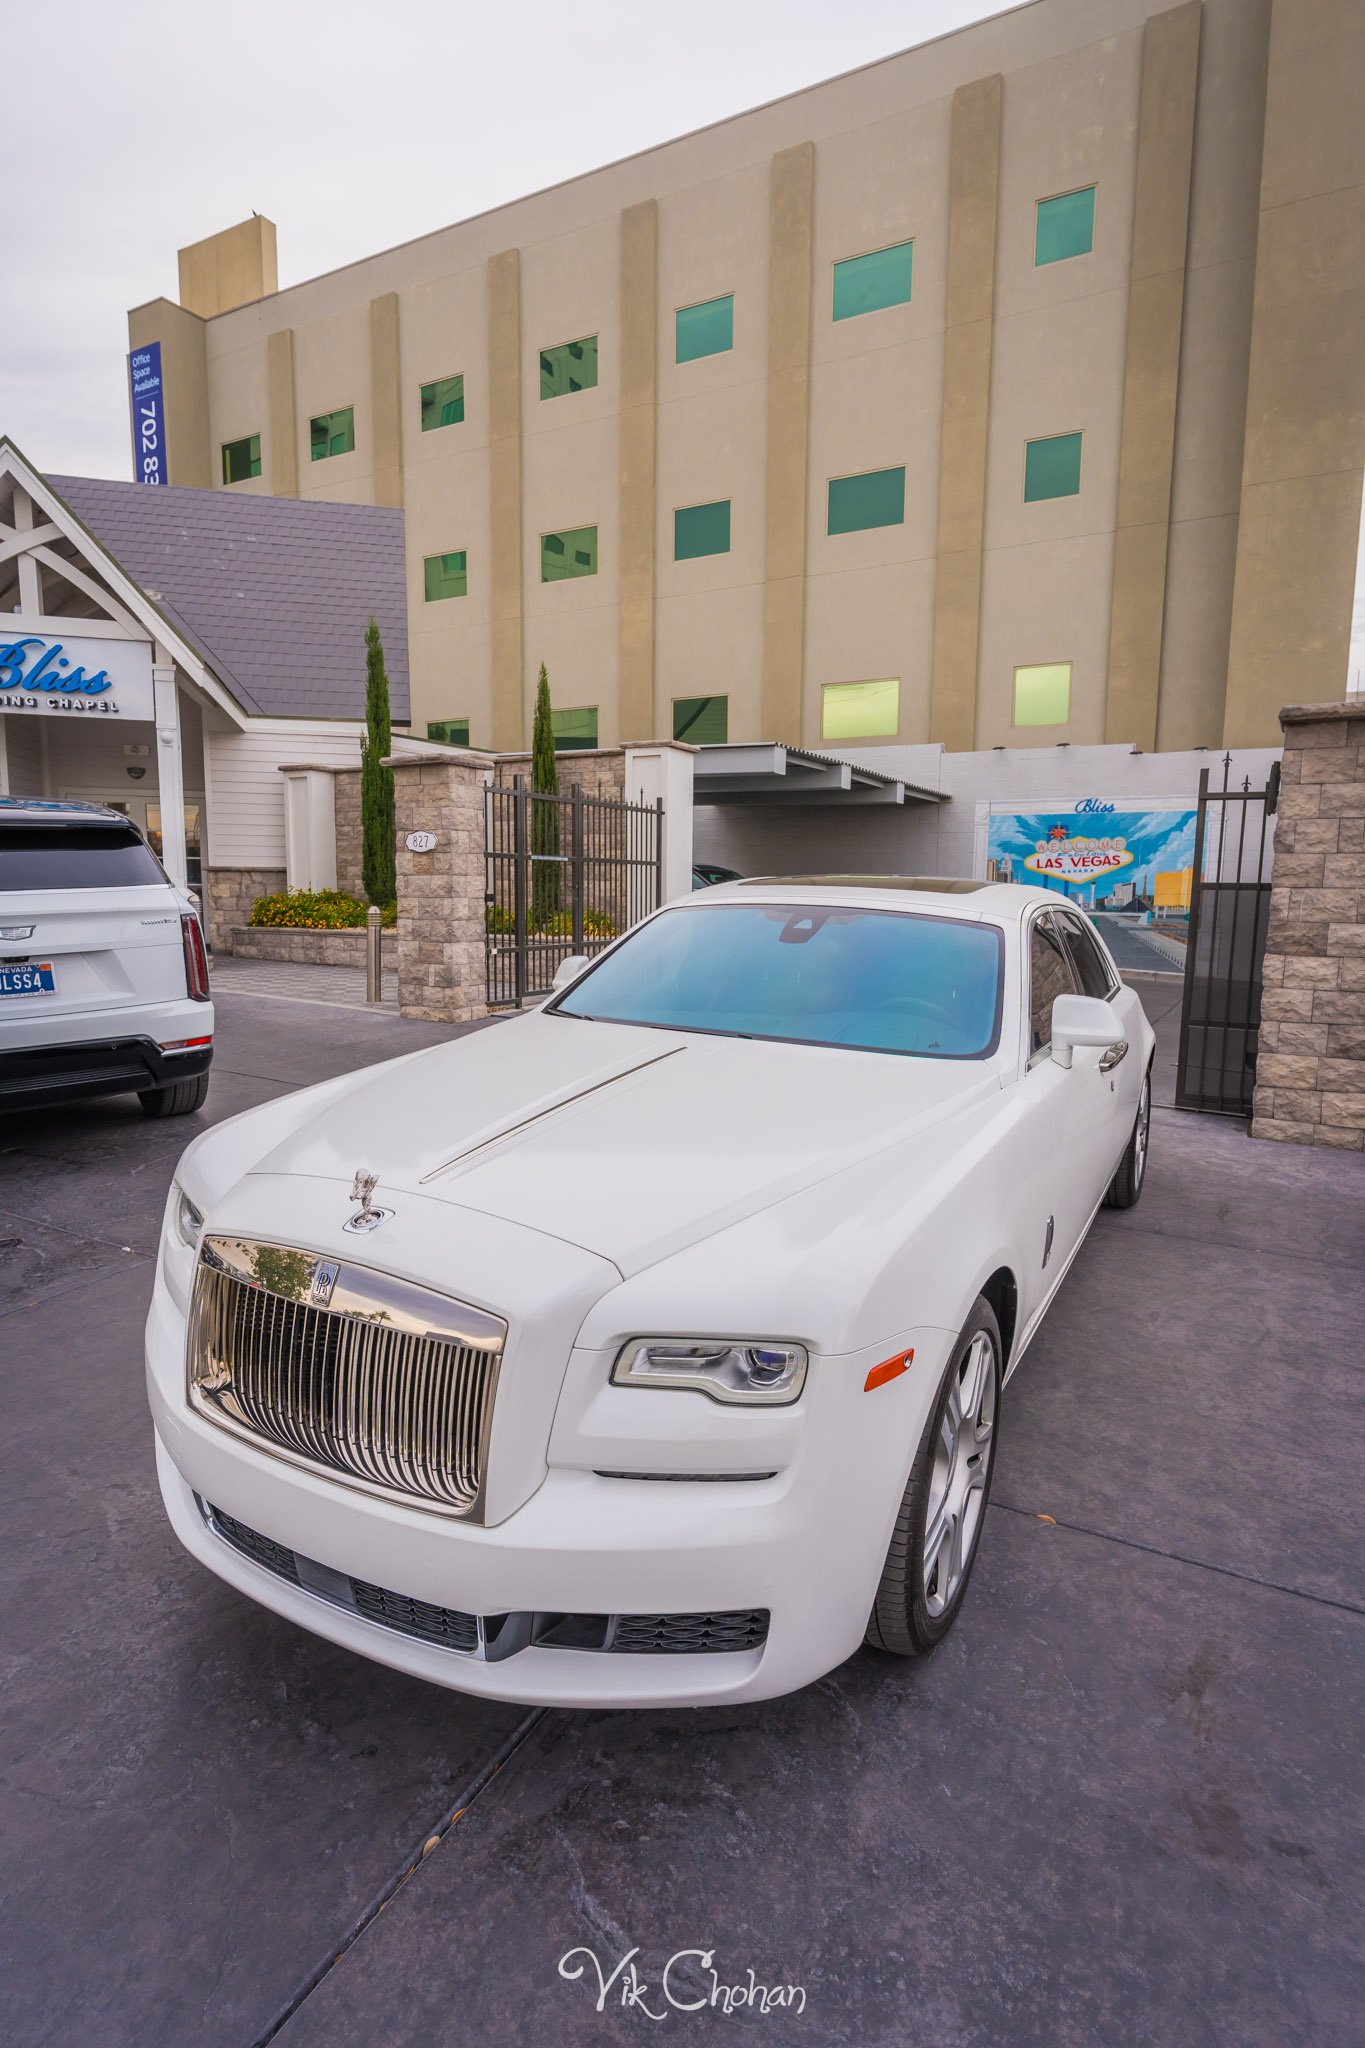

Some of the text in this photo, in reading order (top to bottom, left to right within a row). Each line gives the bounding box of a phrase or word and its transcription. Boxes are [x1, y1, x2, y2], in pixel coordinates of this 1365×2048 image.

[132, 354, 151, 367] Office
[133, 366, 151, 381] Space
[134, 376, 160, 393] Available
[140, 401, 160, 485] 702 83
[0, 638, 113, 695] Bliss
[46, 697, 118, 712] CHAPEL
[1074, 798, 1116, 813] Bliss
[412, 835, 429, 848] 827
[1036, 838, 1123, 851] WELCOME
[1036, 855, 1121, 869] LAS VEGAS
[0, 966, 33, 975] NEVADA
[0, 972, 42, 991] LSS4
